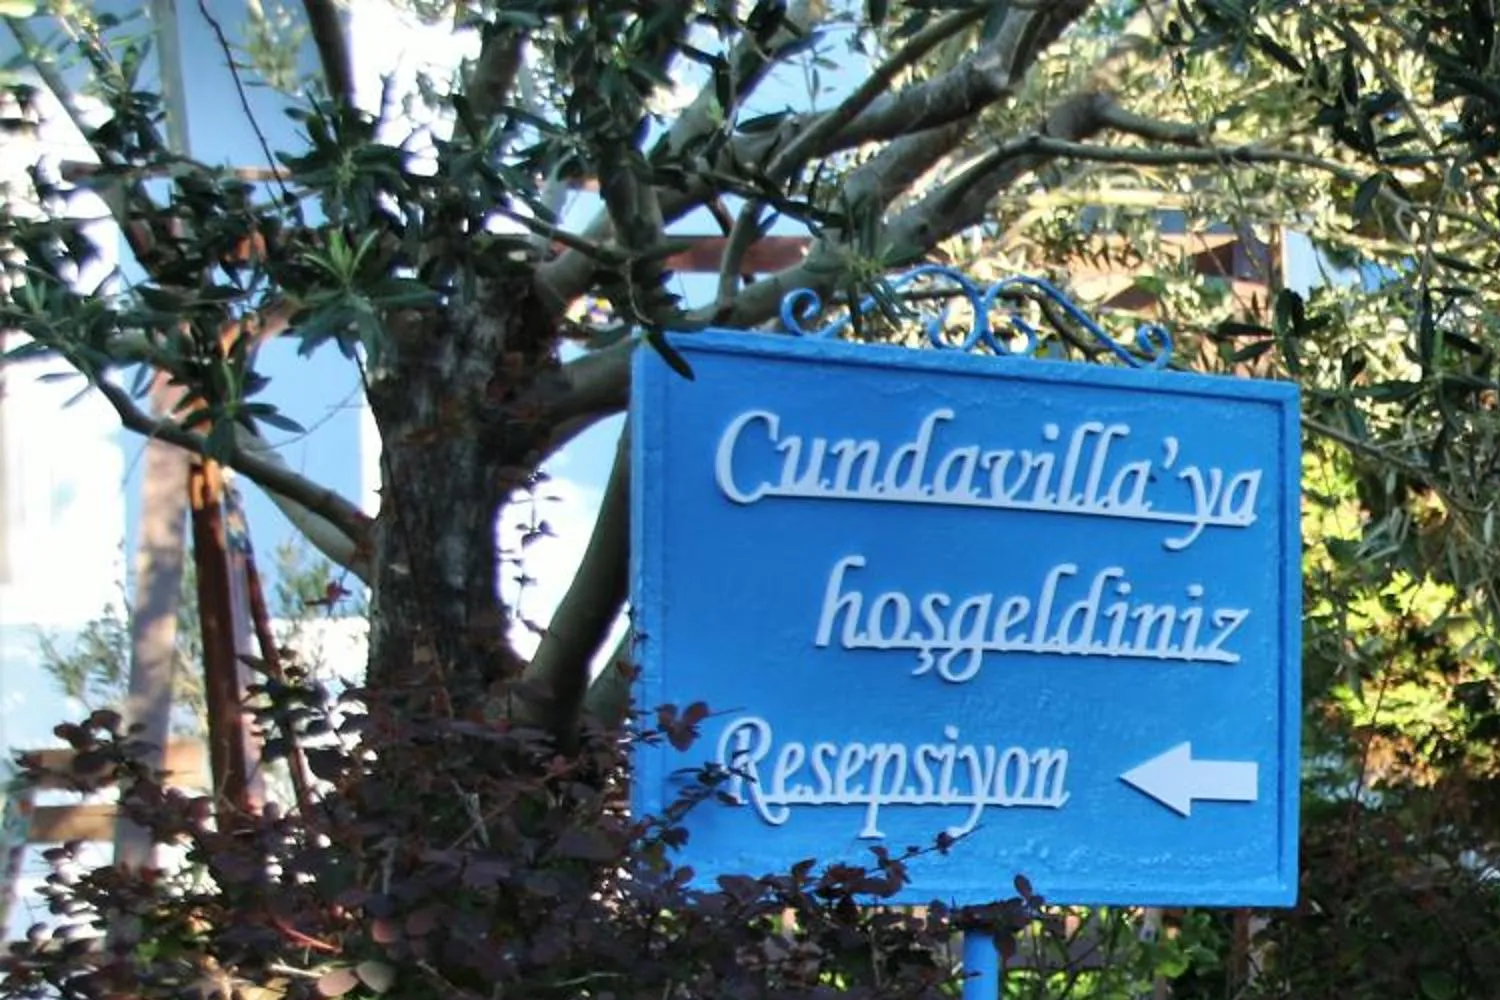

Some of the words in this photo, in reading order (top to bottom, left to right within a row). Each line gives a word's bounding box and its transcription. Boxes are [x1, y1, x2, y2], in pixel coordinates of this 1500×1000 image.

[714, 408, 1262, 550] Cundavilla'ya
[815, 554, 1250, 683] hoşgeldiniz
[716, 716, 1070, 839] Resepsiyon
